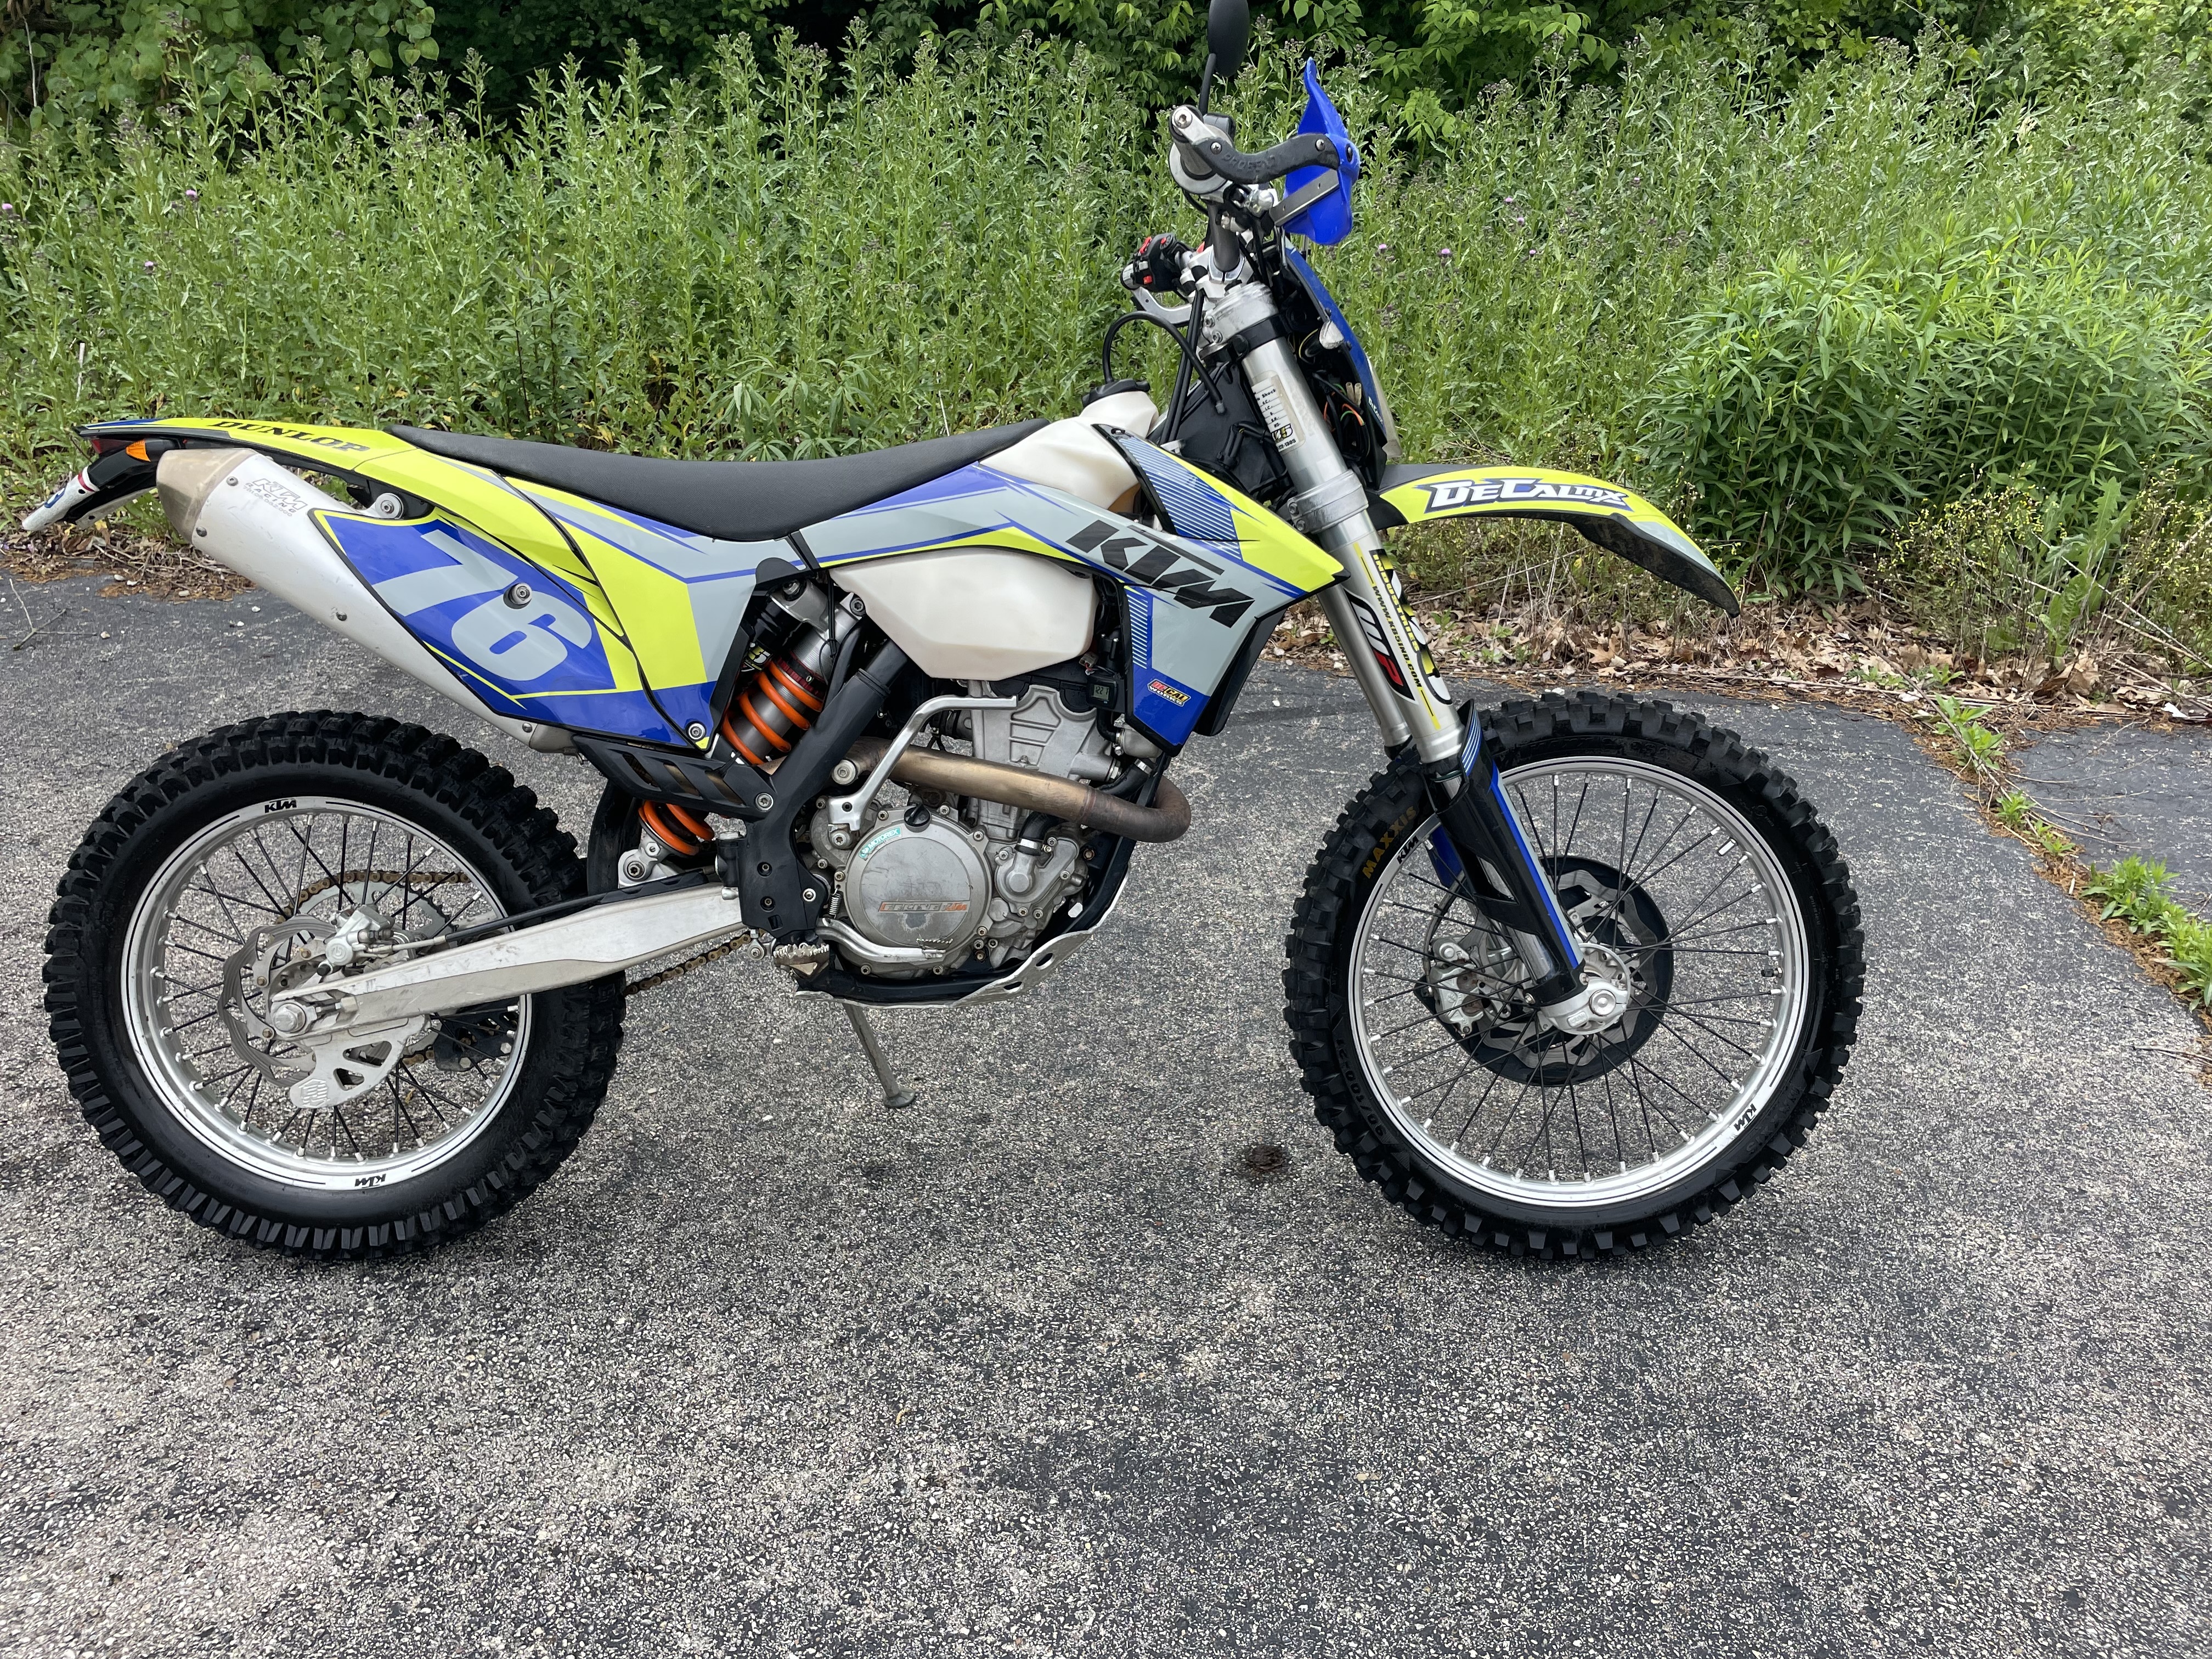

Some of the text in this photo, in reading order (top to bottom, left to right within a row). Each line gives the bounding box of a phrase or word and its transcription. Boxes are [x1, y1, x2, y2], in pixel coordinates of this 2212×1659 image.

[210, 421, 371, 452] DUNLOP
[245, 482, 297, 513] RACING
[252, 478, 308, 511] KTM
[1065, 520, 1255, 629] KTM
[371, 529, 592, 681] 76
[1373, 554, 1420, 652] INDUSTRIES
[1149, 686, 1183, 705] WORKS
[264, 798, 297, 814] KTM
[868, 828, 899, 850] MOTOREX
[1362, 806, 1417, 879] MAXXIS
[1397, 836, 1419, 865] KTM
[1734, 1103, 1757, 1132] KTM
[354, 1173, 387, 1188] KTM
